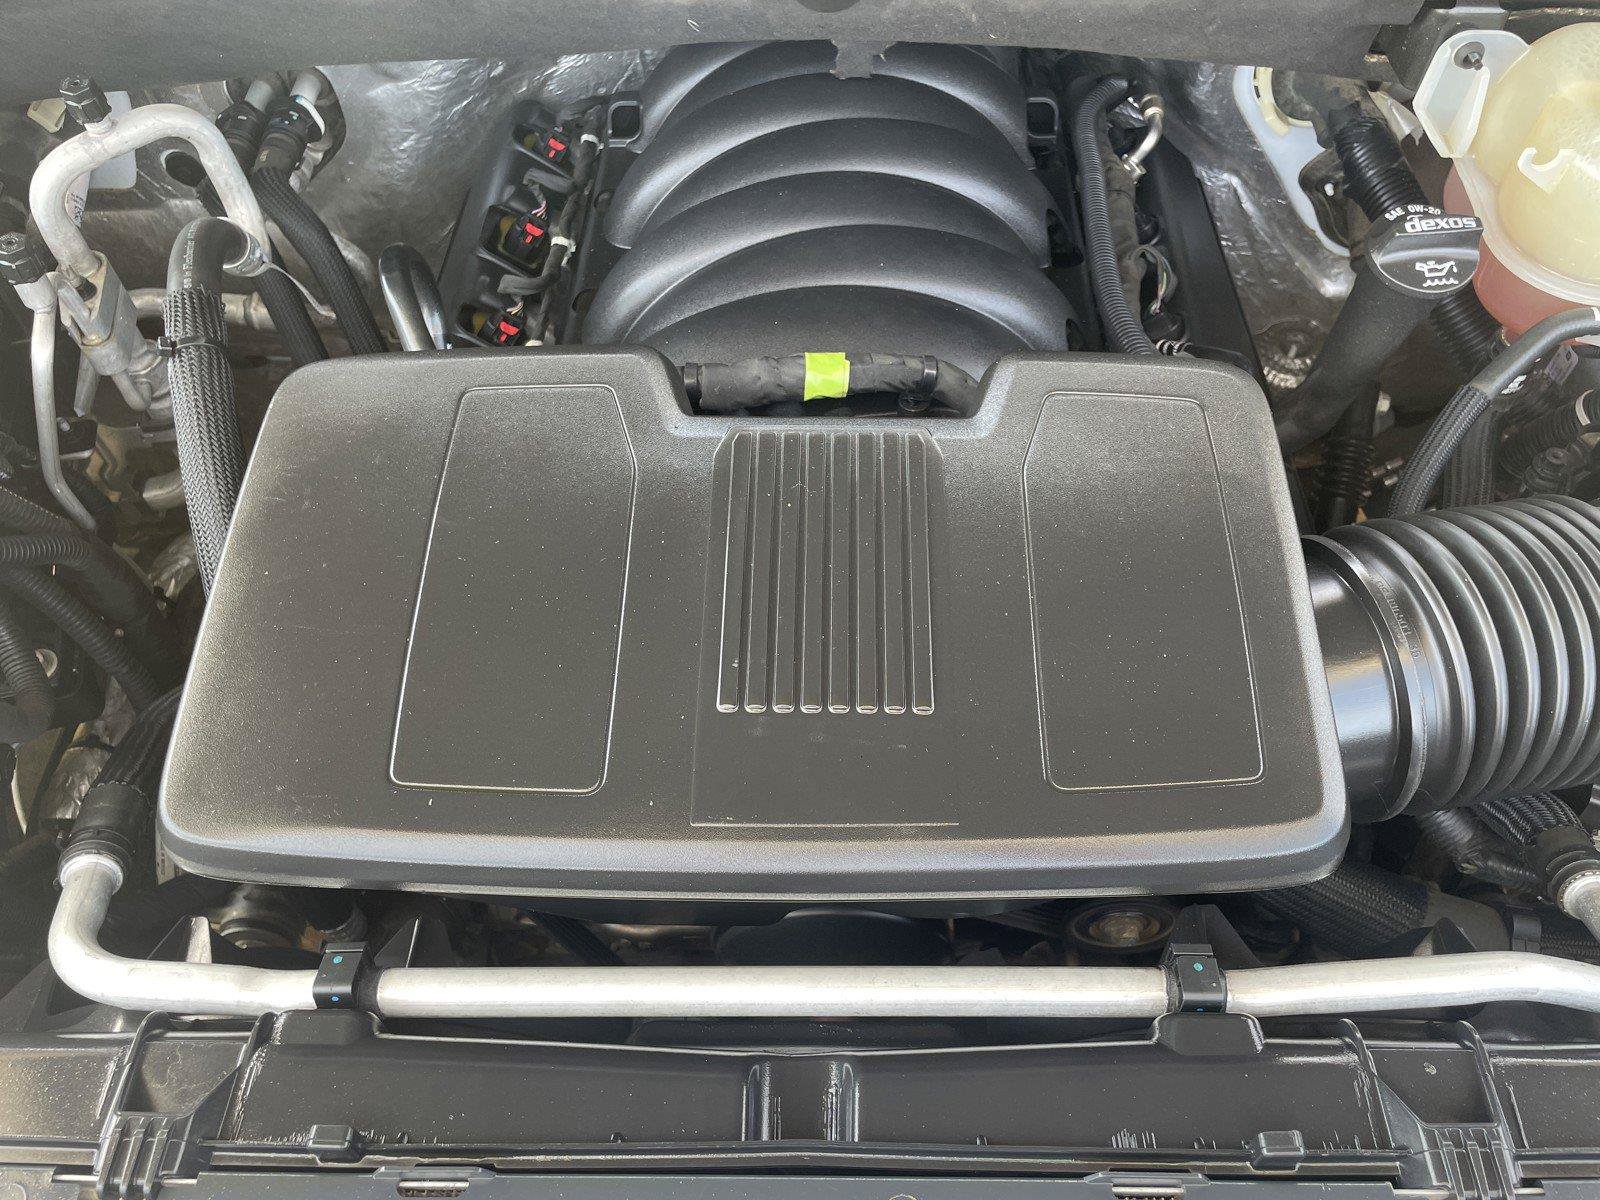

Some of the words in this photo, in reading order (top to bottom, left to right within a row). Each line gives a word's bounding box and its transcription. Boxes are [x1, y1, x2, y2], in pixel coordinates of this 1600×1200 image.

[1384, 207, 1405, 221] SAE
[1407, 204, 1441, 215] 0W-20
[1404, 215, 1477, 233] dexos
